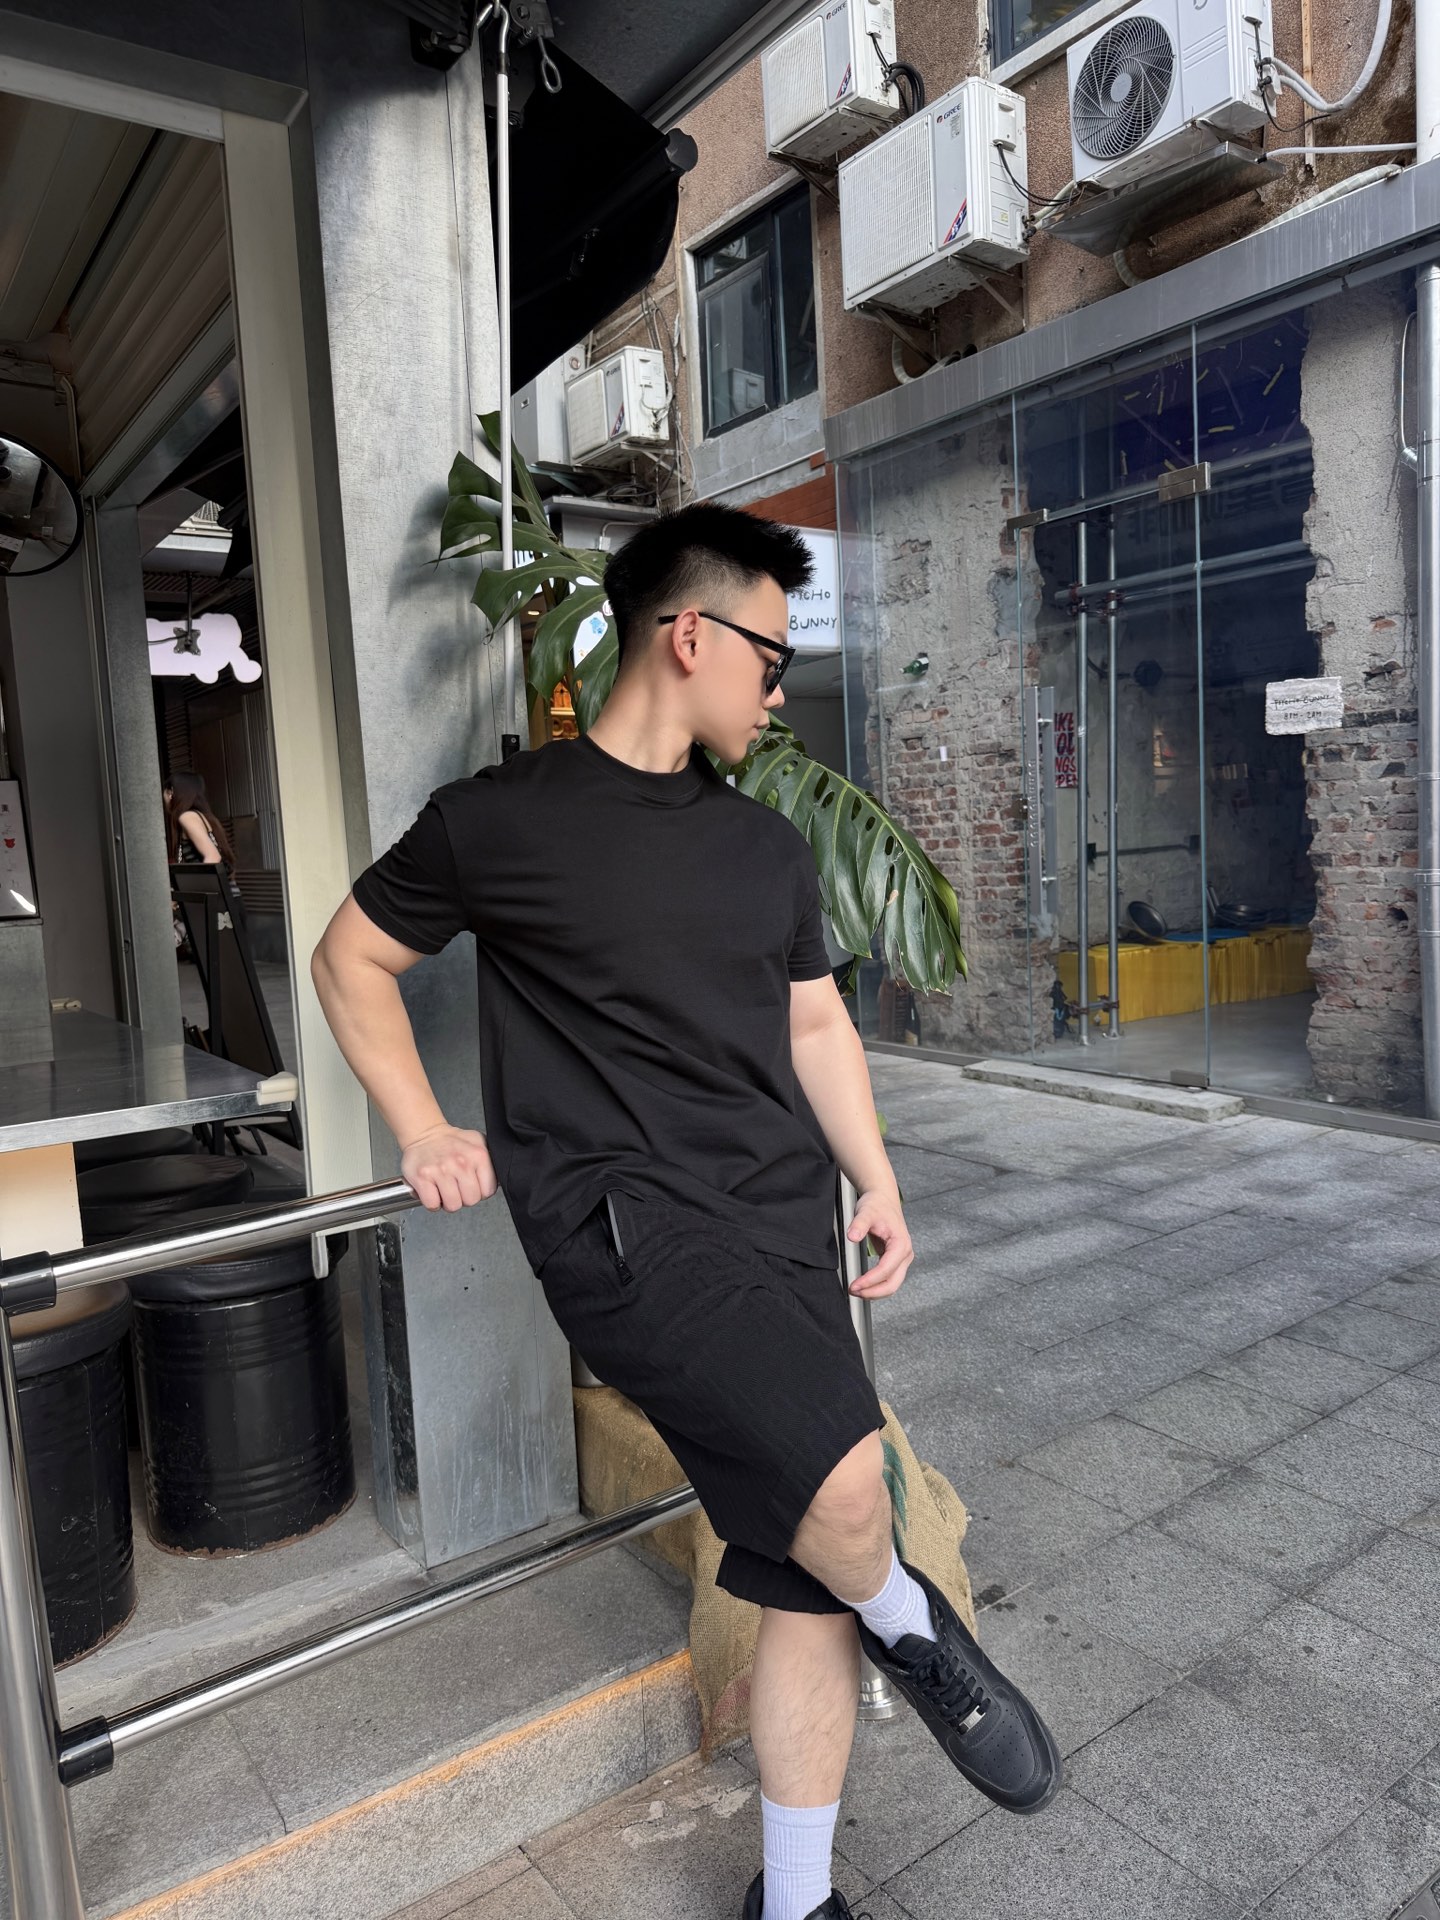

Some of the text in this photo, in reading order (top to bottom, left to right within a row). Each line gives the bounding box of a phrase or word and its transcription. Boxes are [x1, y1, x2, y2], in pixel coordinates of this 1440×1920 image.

[789, 615, 838, 631] BUNNY
[1055, 732, 1075, 755] OL
[1055, 756, 1077, 773] NGS
